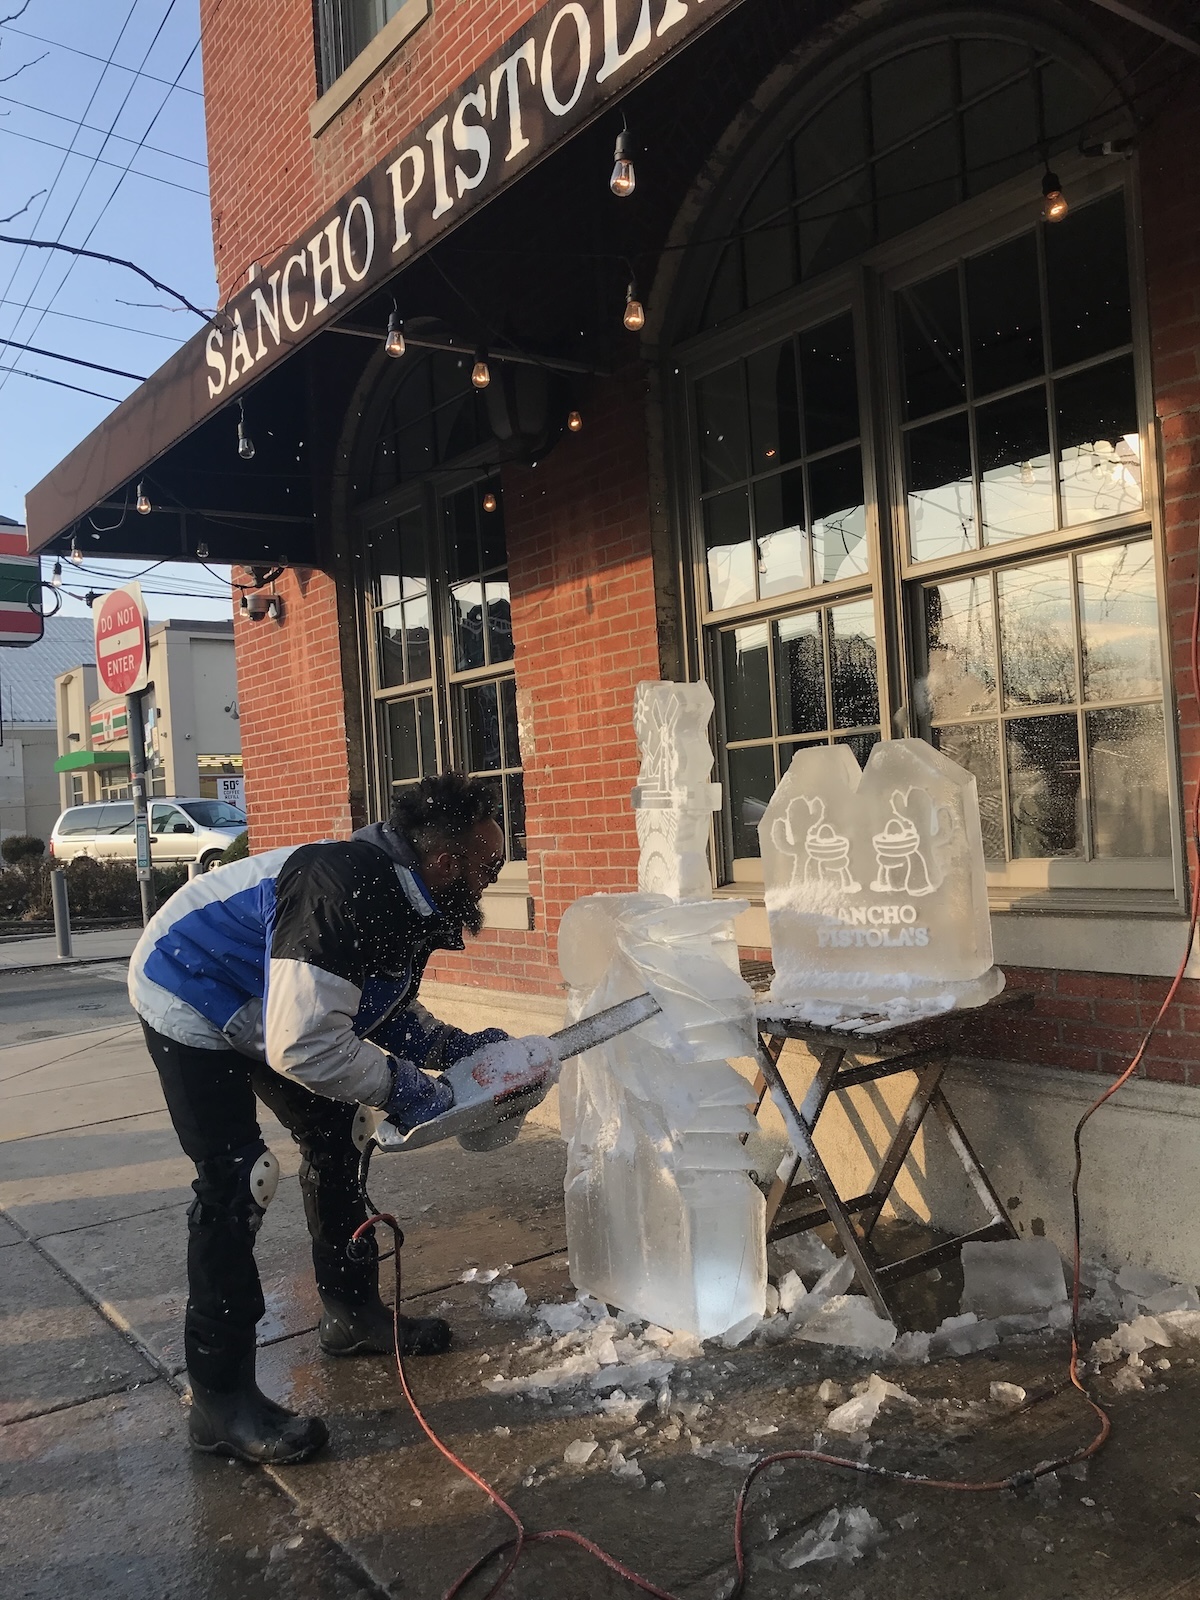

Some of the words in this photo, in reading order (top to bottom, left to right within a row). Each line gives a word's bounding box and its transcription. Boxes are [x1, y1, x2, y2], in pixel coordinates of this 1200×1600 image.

[205, 196, 375, 399] SANCHO
[386, 0, 704, 253] PISTOL
[101, 615, 113, 633] DO
[117, 606, 135, 627] NOT
[107, 654, 135, 677] ENTER
[817, 926, 930, 948] PISTOLA'S
